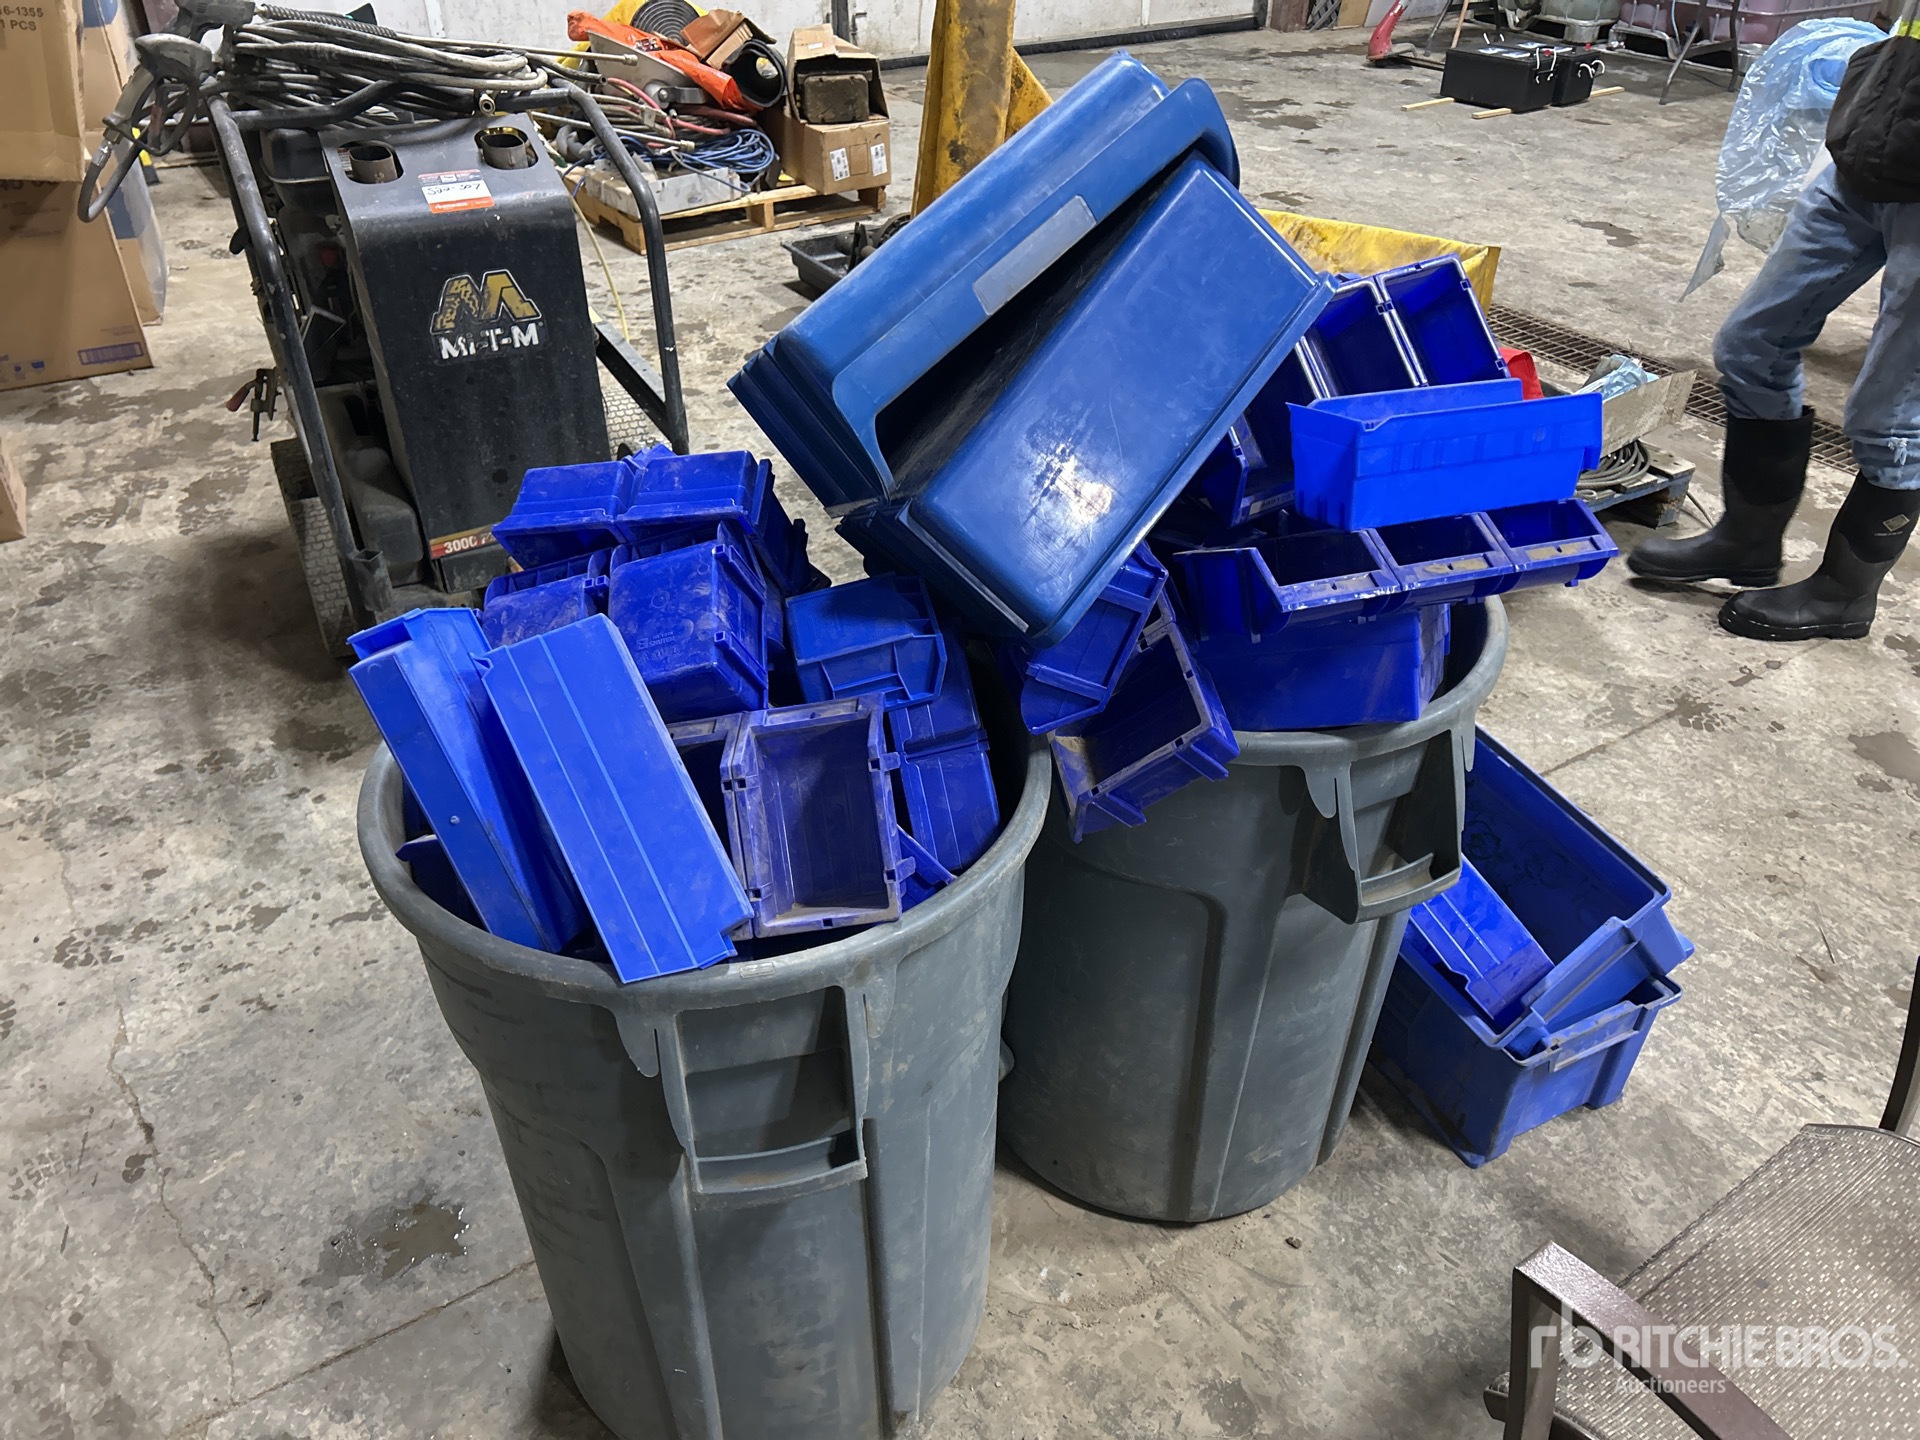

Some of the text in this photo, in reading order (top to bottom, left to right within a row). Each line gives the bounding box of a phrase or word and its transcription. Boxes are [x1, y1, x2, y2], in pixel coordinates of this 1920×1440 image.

[0, 5, 44, 18] 6-1355
[10, 19, 37, 31] PCS
[439, 322, 539, 360] Mi-T-M
